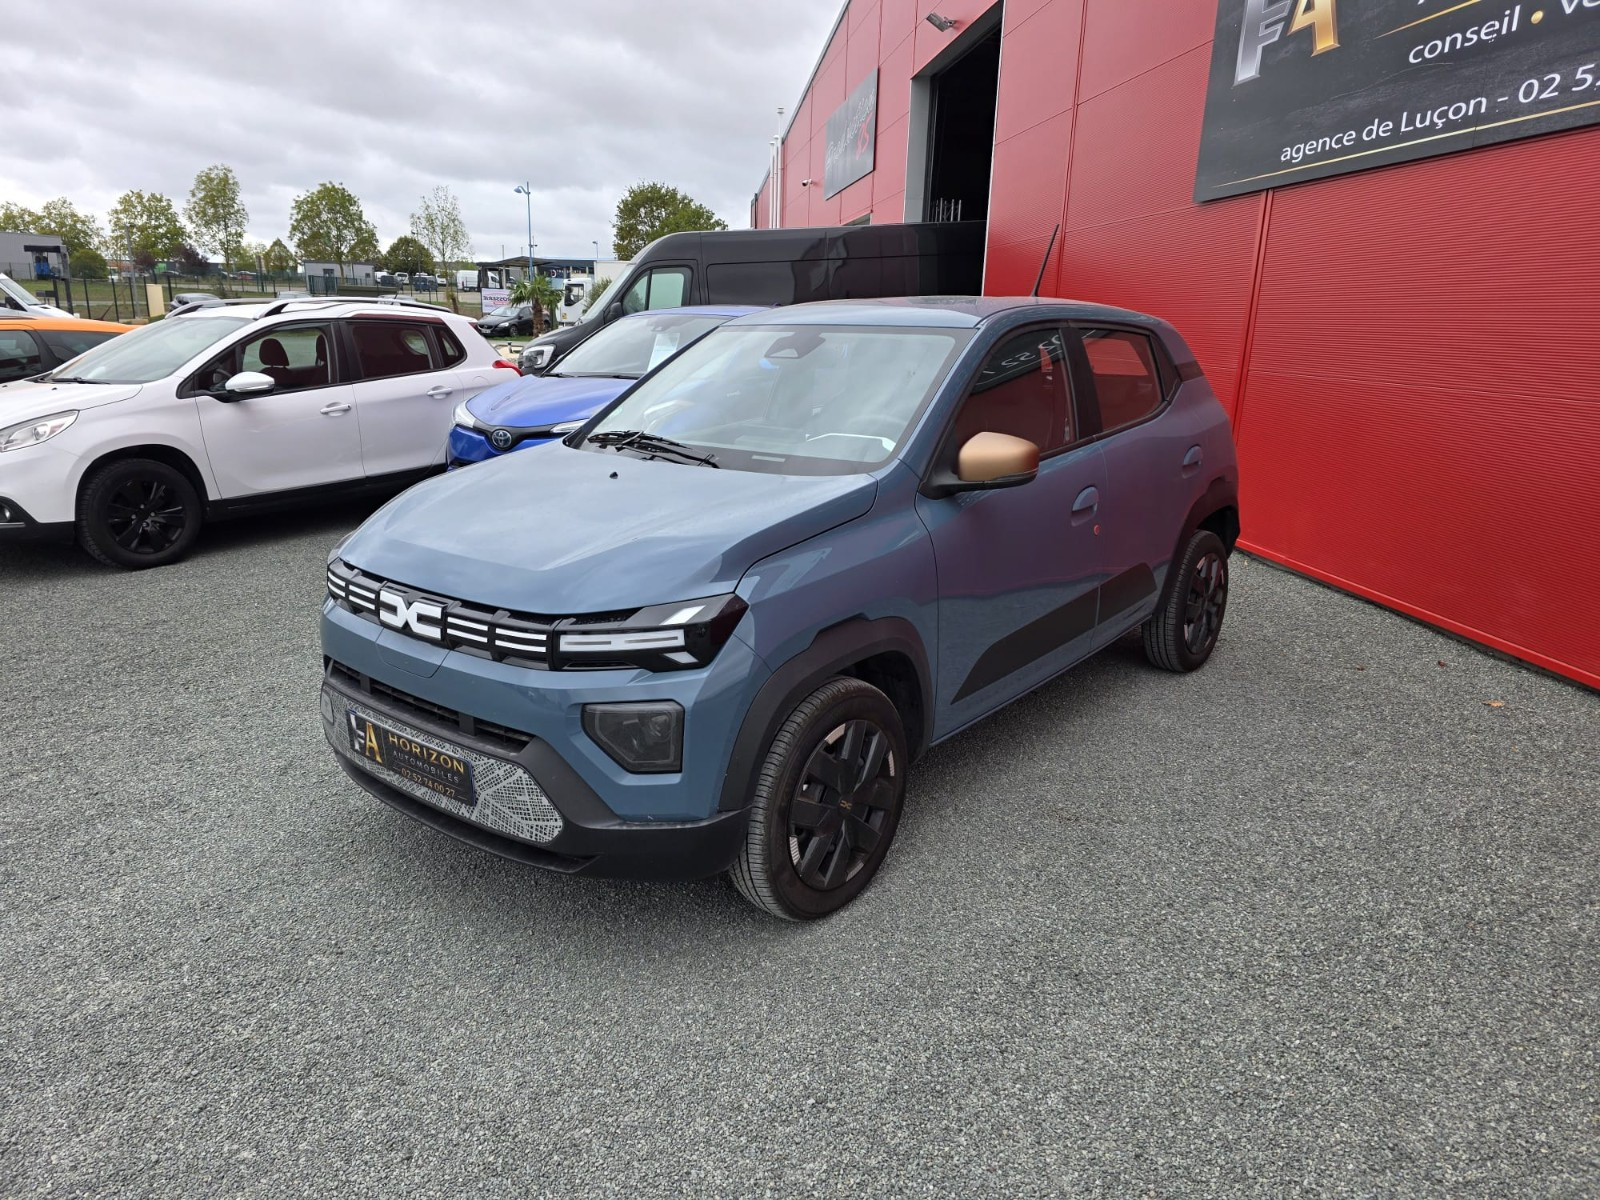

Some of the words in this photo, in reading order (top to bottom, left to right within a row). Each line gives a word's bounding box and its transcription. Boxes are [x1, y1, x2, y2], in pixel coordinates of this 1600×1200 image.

[1408, 5, 1521, 64] conseil
[1280, 130, 1355, 163] agence
[1362, 118, 1393, 141] de
[1401, 97, 1487, 131] Luçon
[1518, 73, 1561, 103] 02
[1571, 64, 1600, 91] 5
[389, 733, 464, 774] HORIZON
[393, 751, 459, 783] AUTOMOBILES
